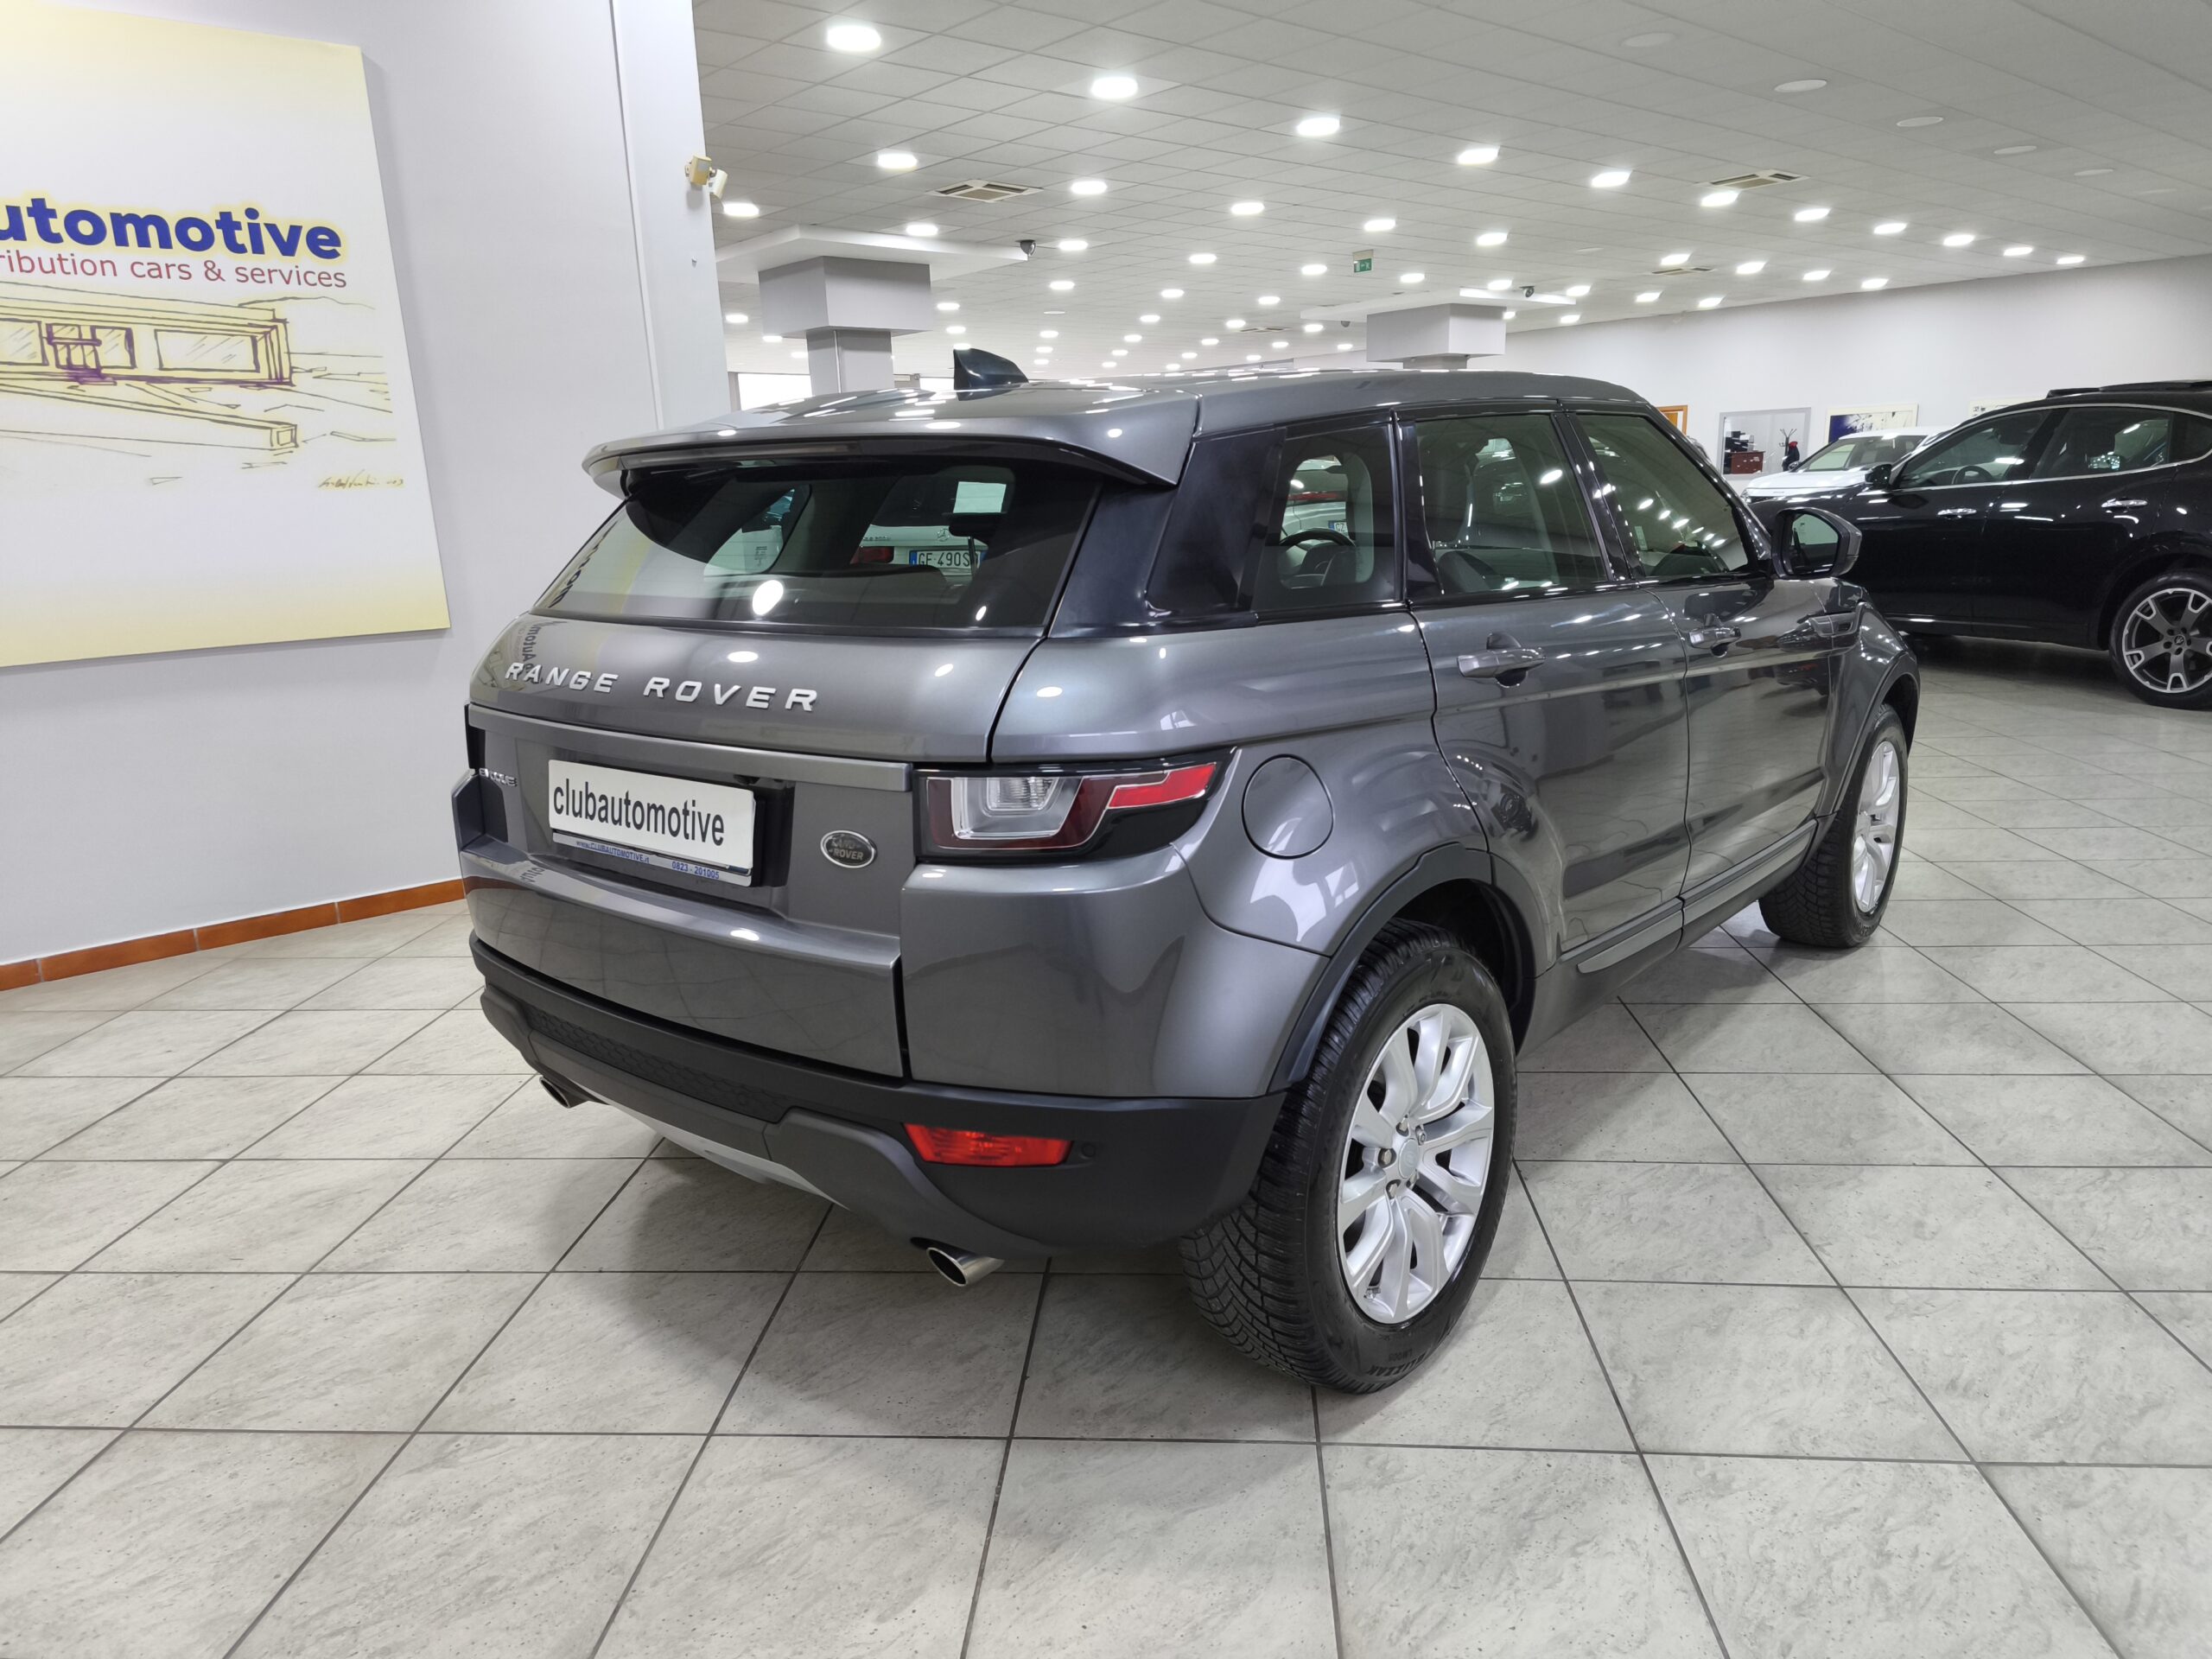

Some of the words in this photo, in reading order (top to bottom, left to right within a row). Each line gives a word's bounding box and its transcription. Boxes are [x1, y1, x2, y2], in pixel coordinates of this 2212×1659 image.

[130, 258, 193, 281] cars
[204, 260, 226, 283] &
[236, 264, 347, 289] services
[938, 551, 978, 568] 490S
[505, 662, 619, 694] RANGE
[643, 677, 818, 712] ROVER
[553, 779, 725, 847] clubautomotive
[832, 848, 864, 861] ROVER
[671, 861, 689, 872] 0823
[694, 866, 720, 880] 201005
